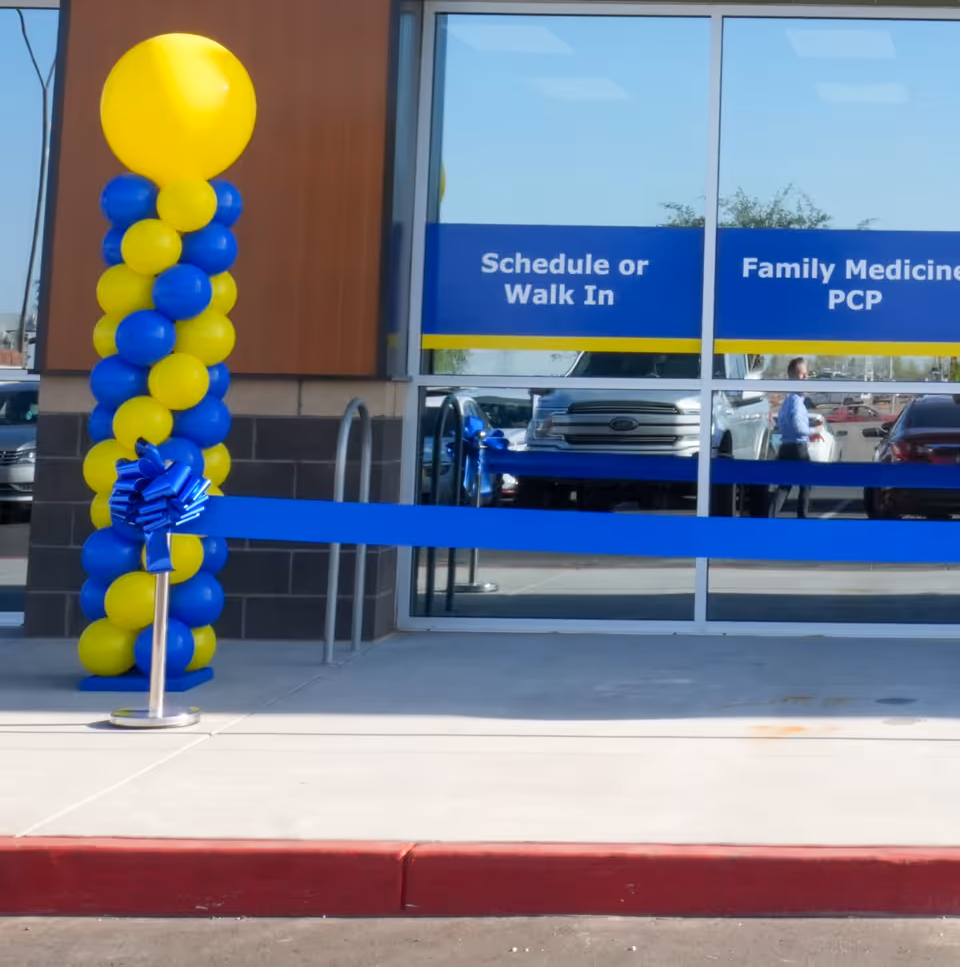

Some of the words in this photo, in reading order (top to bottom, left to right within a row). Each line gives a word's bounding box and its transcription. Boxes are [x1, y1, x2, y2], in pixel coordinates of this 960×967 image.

[481, 251, 610, 275] Schedule
[618, 258, 650, 276] or
[742, 257, 836, 284] Family
[504, 283, 575, 305] Walk
[583, 285, 615, 306] In
[828, 289, 883, 311] PCP
